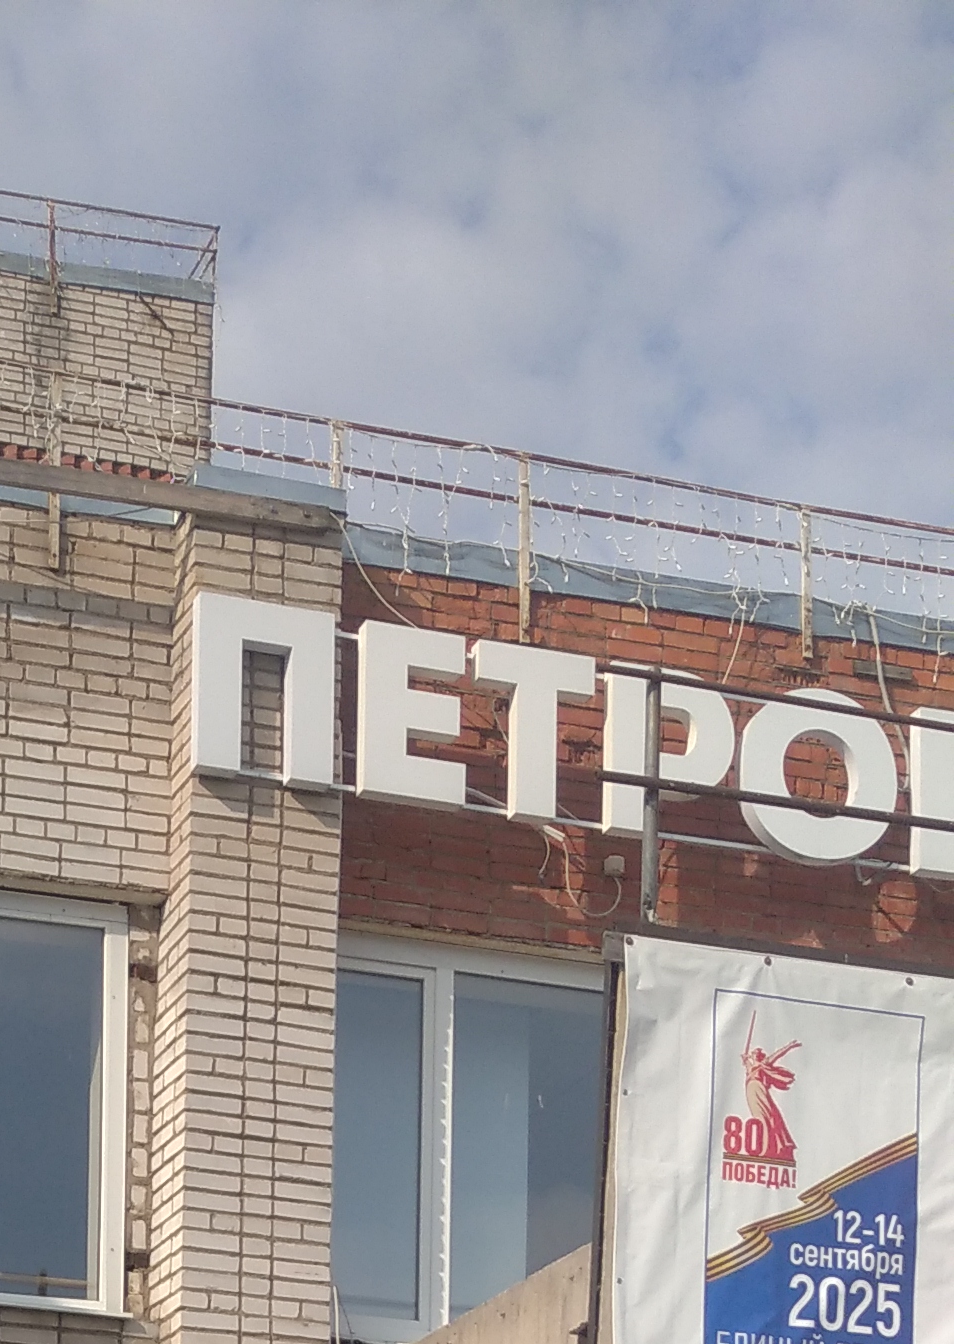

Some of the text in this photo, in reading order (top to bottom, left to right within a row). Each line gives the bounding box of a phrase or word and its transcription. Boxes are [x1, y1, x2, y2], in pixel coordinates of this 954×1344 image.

[723, 1115, 764, 1156] 80
[722, 1161, 797, 1190] ПОБЕДА!
[832, 1208, 905, 1248] 12-14
[789, 1243, 904, 1280] сентября
[788, 1273, 901, 1338] 2025
